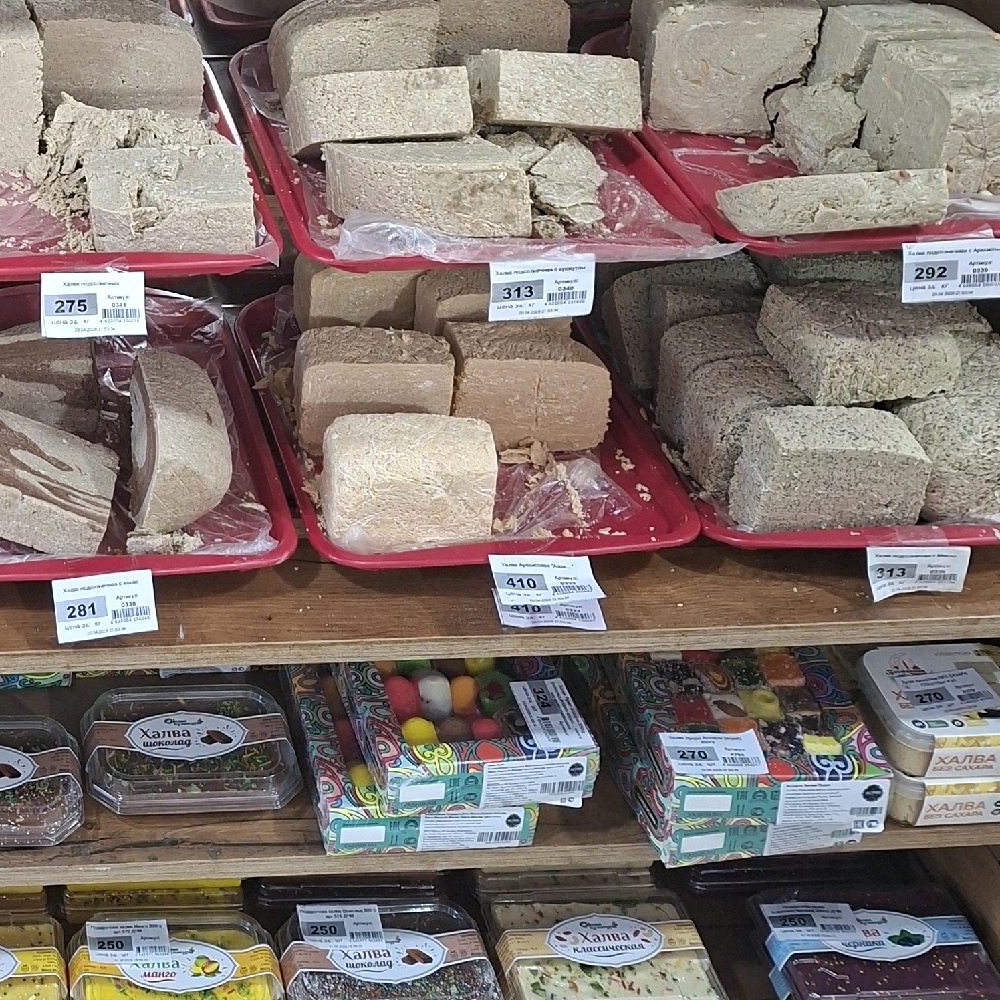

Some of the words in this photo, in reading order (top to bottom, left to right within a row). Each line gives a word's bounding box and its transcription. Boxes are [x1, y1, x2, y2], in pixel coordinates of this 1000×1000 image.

[914, 265, 948, 280] 292
[502, 285, 534, 300] 313
[54, 299, 87, 314] 275
[876, 567, 906, 579] 313
[506, 577, 536, 589] 410
[66, 602, 96, 619] 281
[510, 603, 541, 613] 410
[532, 687, 552, 709] 324
[915, 692, 944, 704] 270
[139, 727, 191, 740] Халва
[142, 738, 192, 748] шоколад
[676, 750, 708, 760] 270
[936, 754, 997, 765] ХАЛВА
[926, 801, 986, 812] ХАЛВА
[944, 811, 984, 819] САХАРА
[780, 917, 806, 927] 250
[310, 925, 337, 935] 250
[577, 931, 631, 944] Халва
[97, 940, 124, 950] 250
[572, 943, 646, 954] классическая
[341, 949, 391, 960] Халва
[345, 960, 393, 970] шоколад
[141, 970, 177, 978] манго
